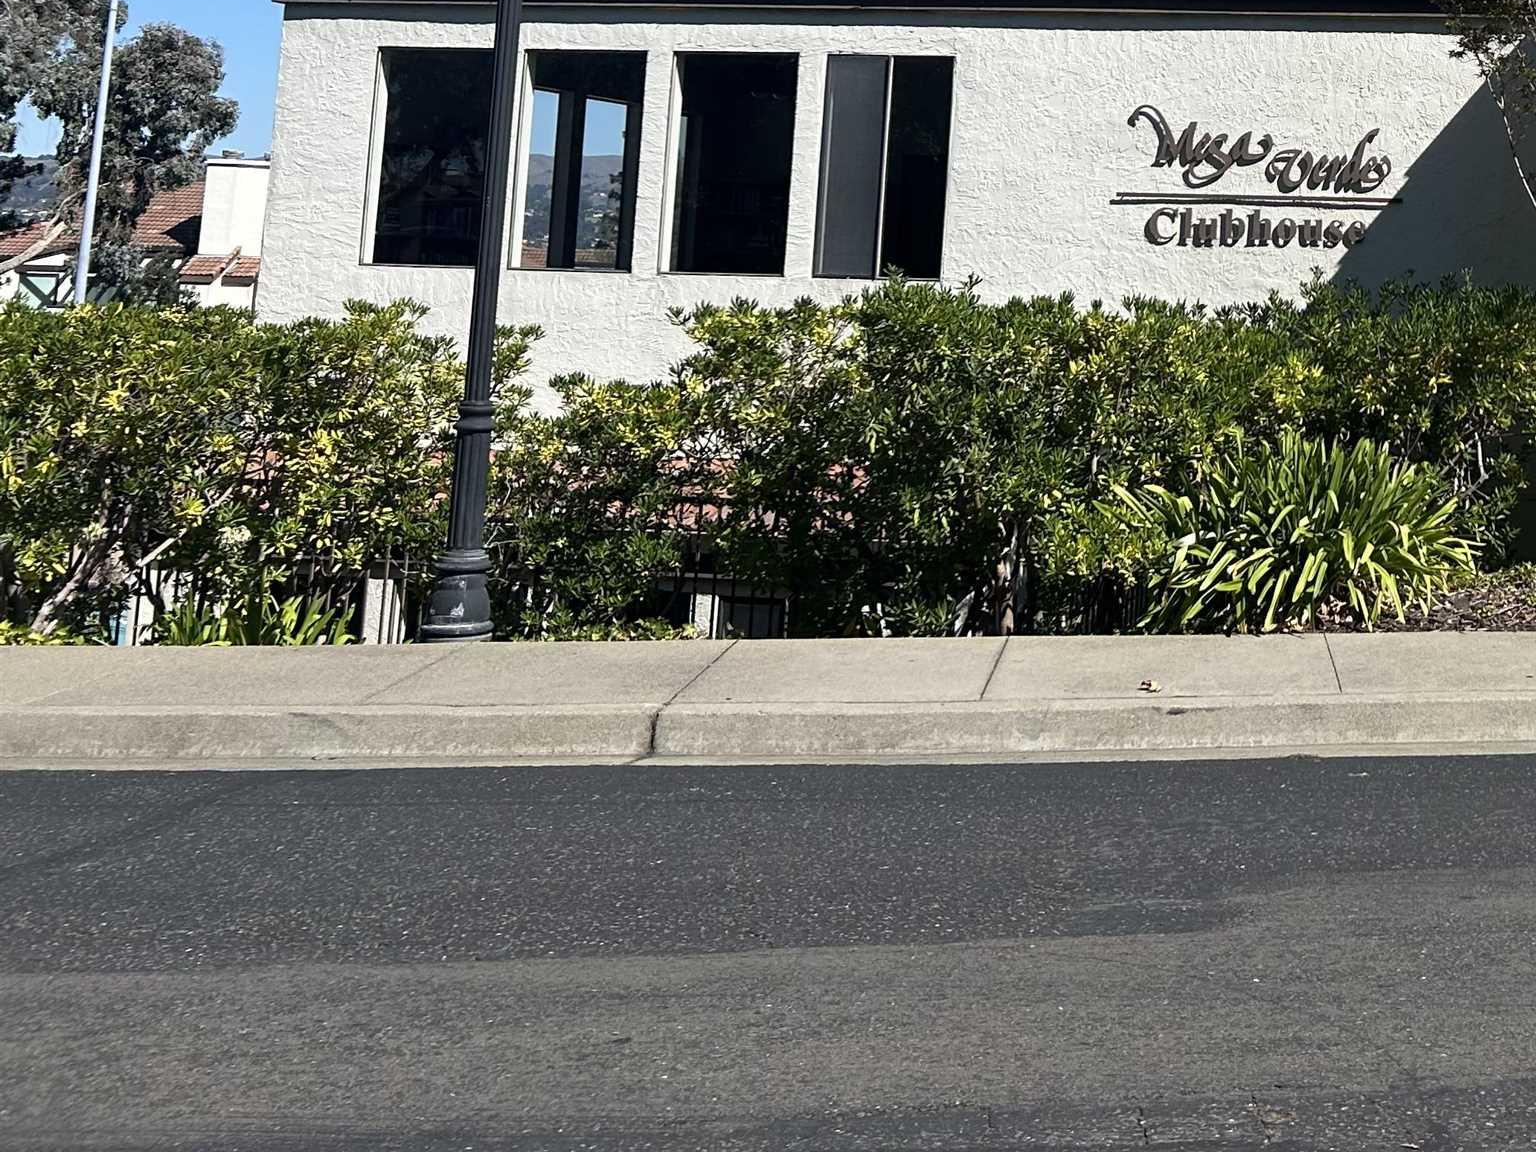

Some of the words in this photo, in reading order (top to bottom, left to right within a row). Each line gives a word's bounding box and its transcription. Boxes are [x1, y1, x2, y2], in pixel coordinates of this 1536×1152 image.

[1127, 104, 1274, 188] Mesa
[1265, 128, 1391, 193] Verde
[1143, 207, 1366, 249] Clubhouse
